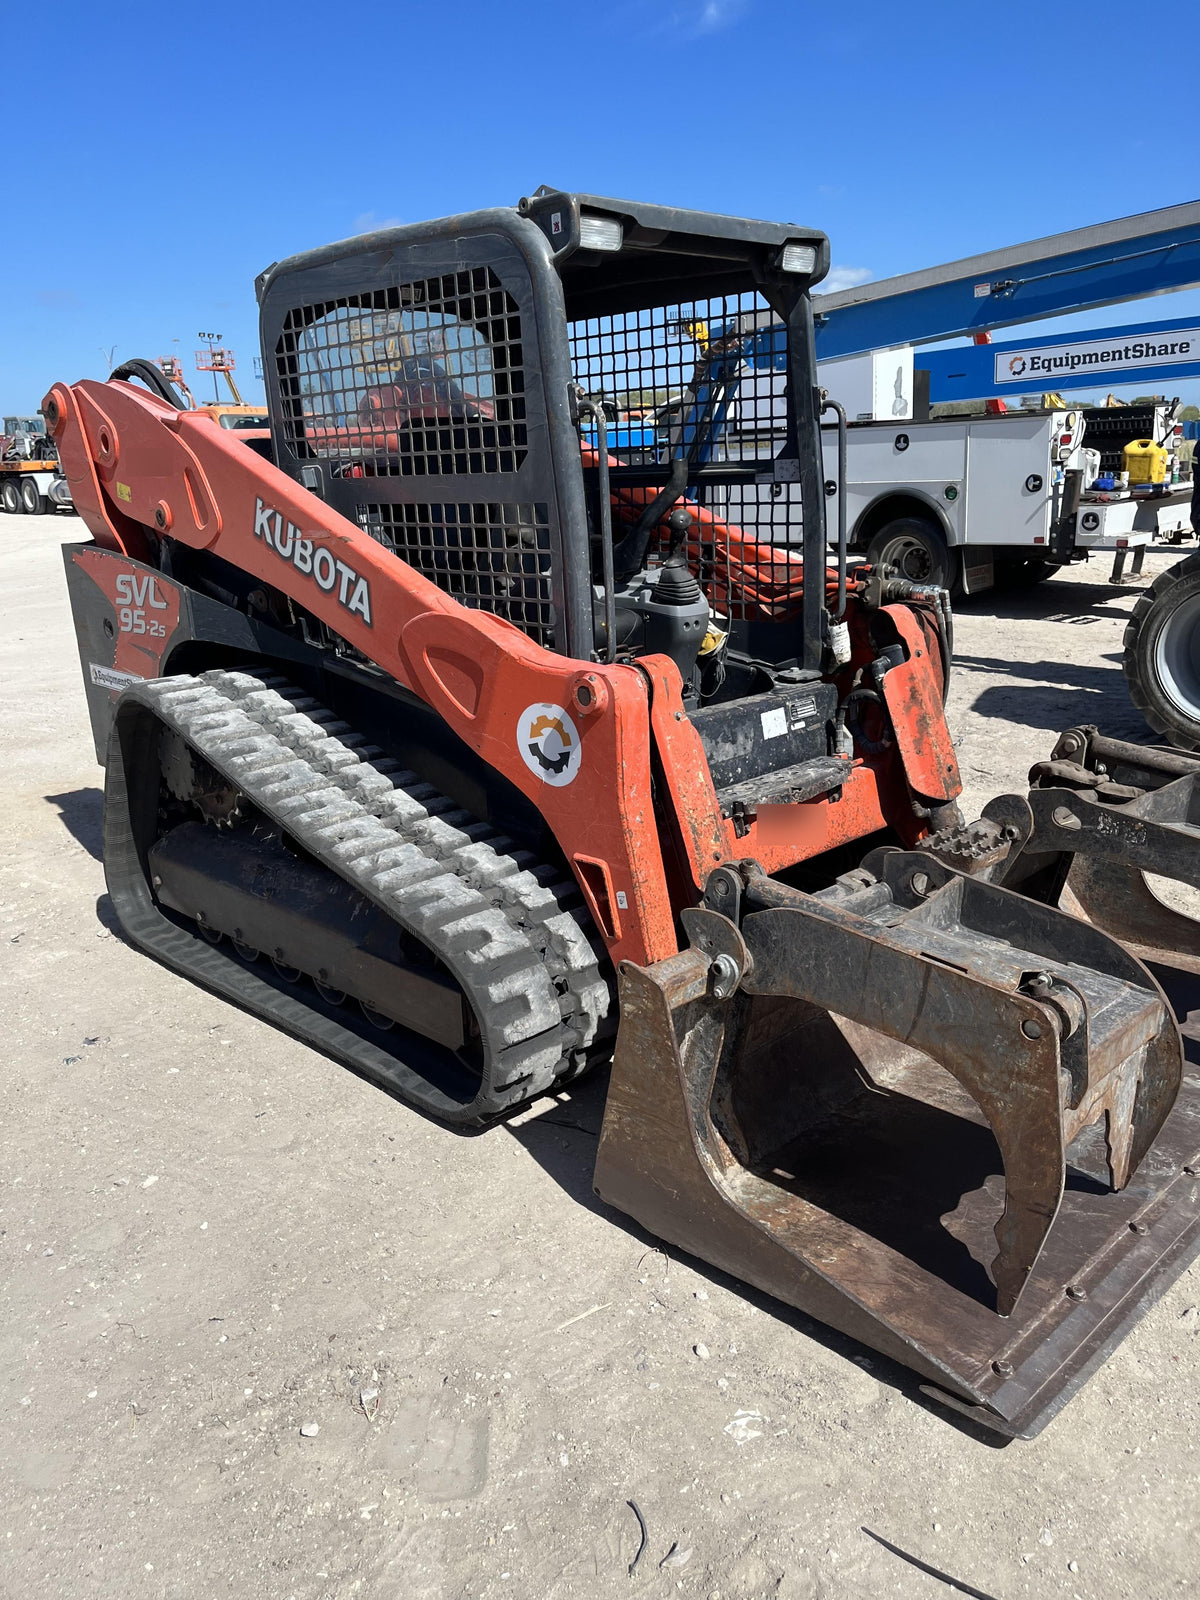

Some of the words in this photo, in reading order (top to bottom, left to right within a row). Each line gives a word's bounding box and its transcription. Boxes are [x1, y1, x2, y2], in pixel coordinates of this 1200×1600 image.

[1030, 341, 1190, 373] EquipmentShare
[254, 497, 372, 625] KUBOTA
[115, 574, 167, 609] SVL
